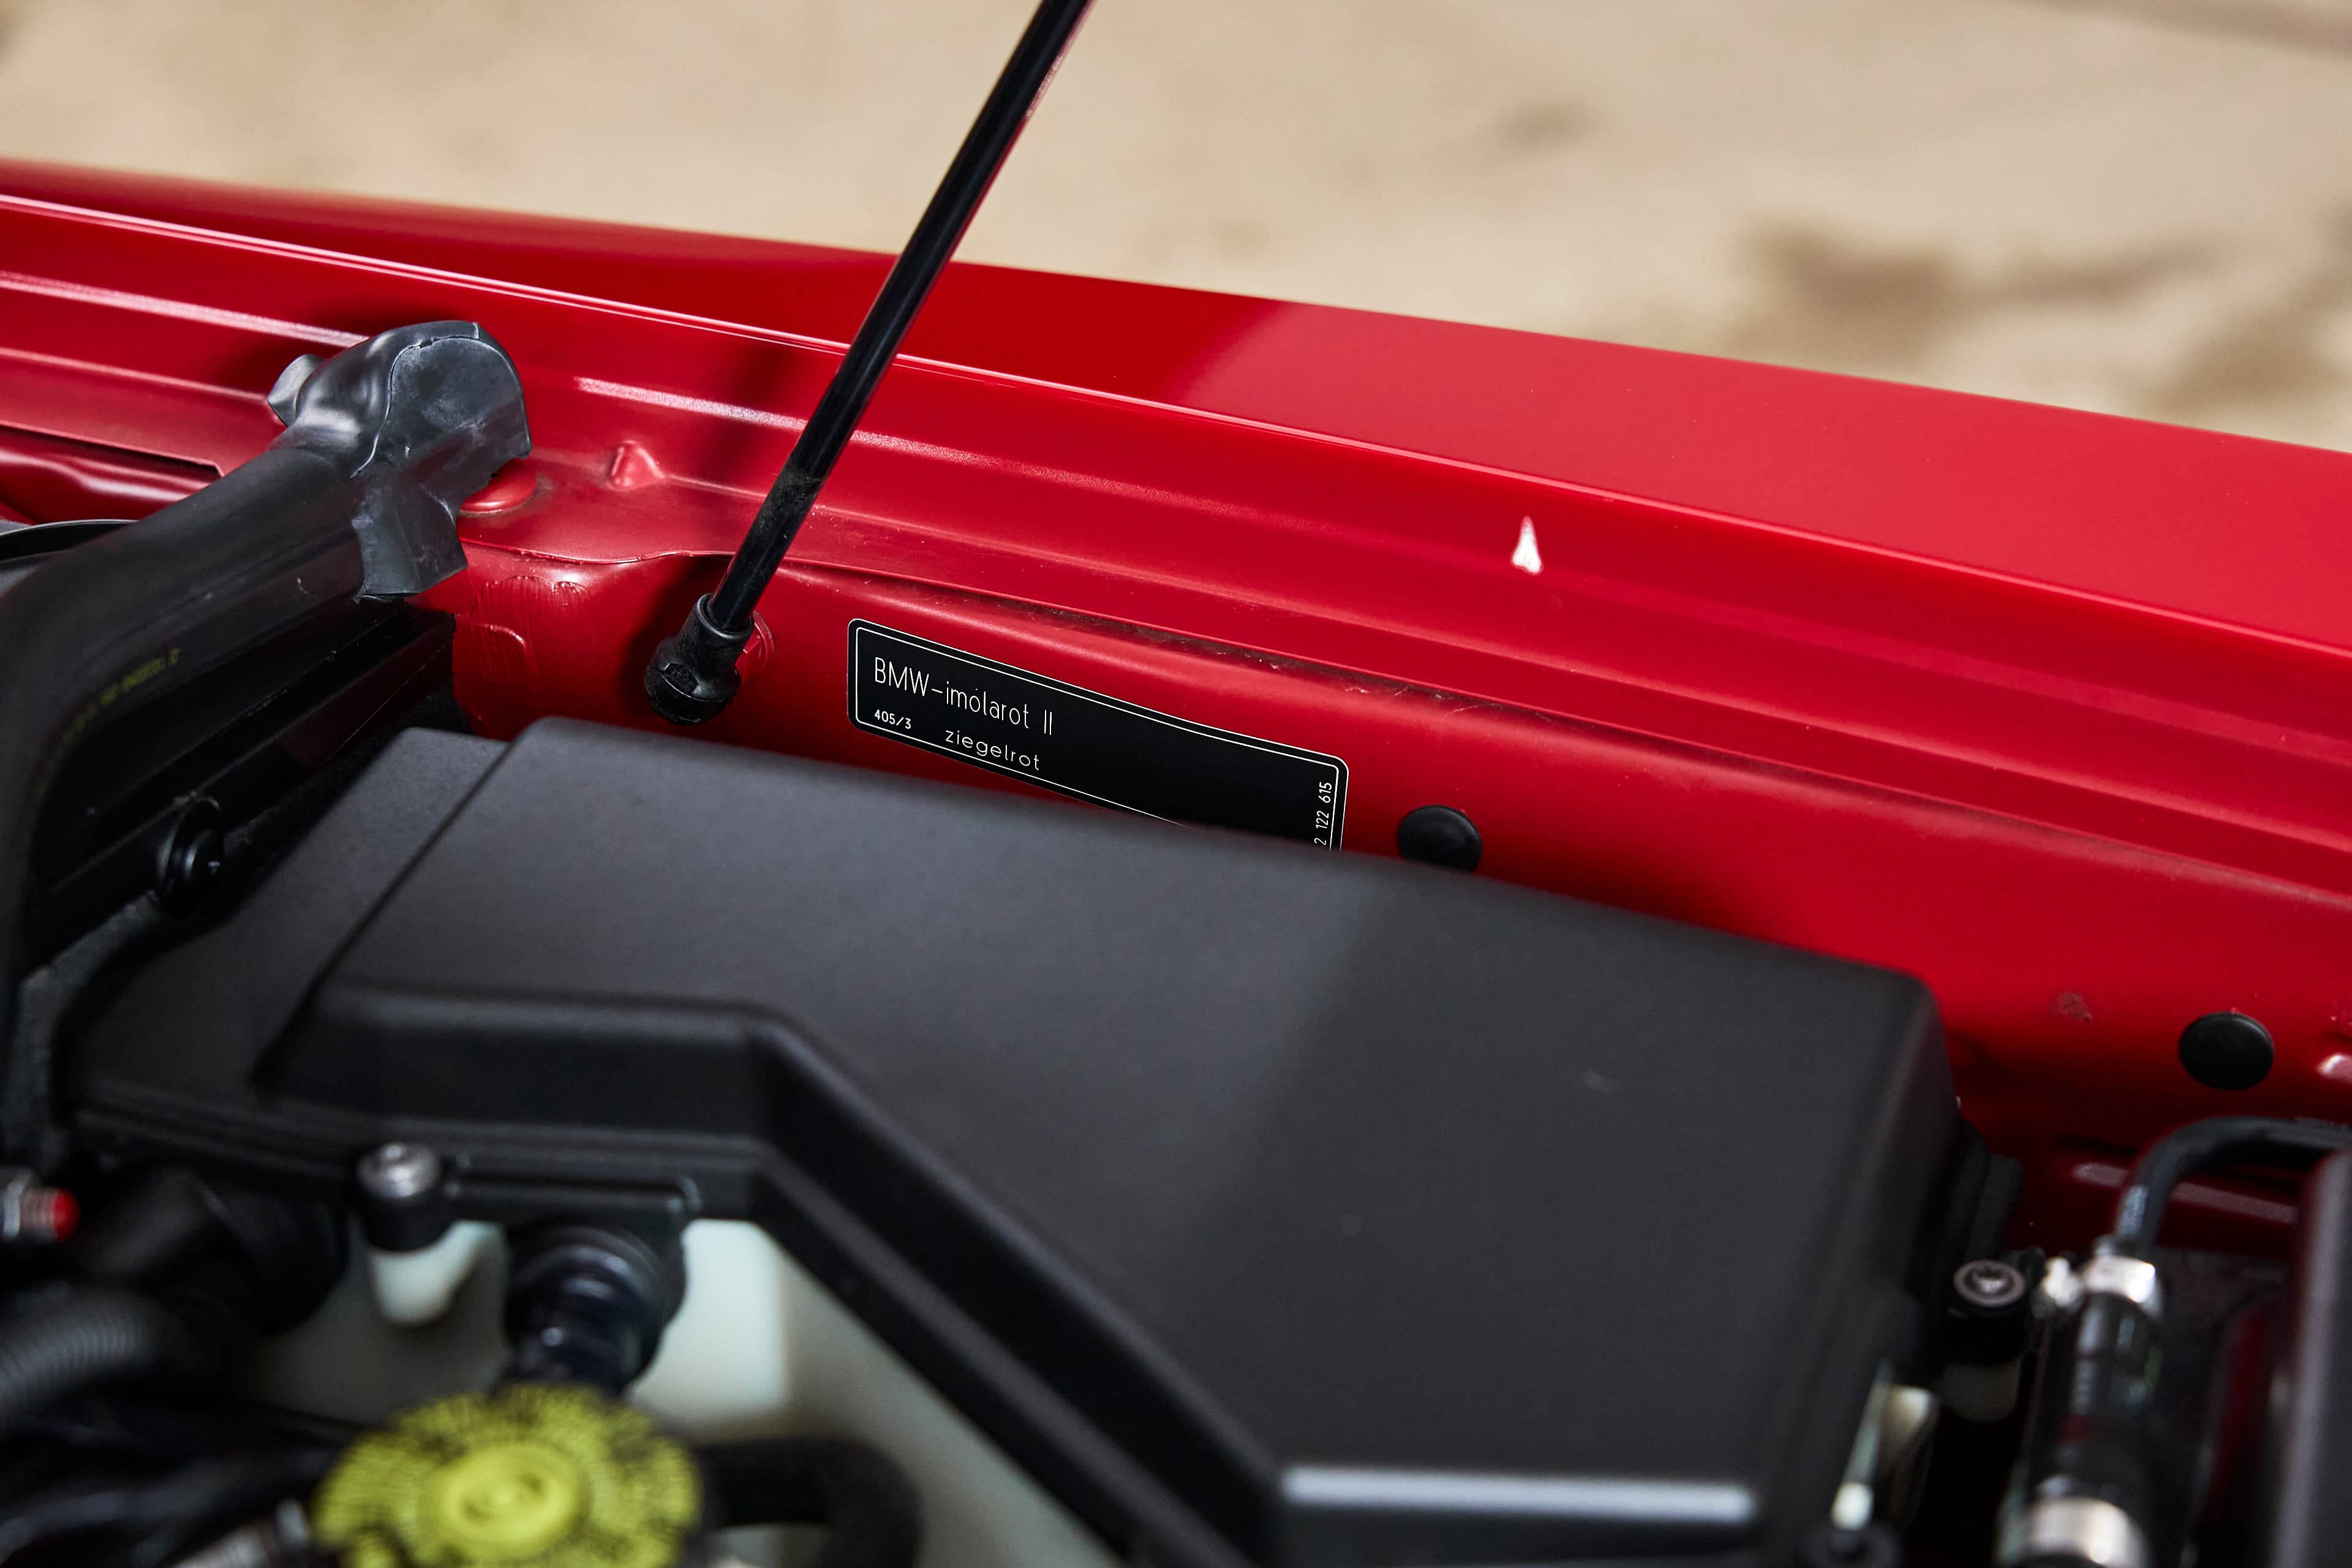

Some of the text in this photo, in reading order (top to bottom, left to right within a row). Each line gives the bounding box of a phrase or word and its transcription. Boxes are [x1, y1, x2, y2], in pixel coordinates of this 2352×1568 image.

[874, 709, 911, 729] 405/3
[875, 657, 1053, 736] BMW-imolarot II
[945, 729, 1039, 771] ziegelrot
[1314, 782, 1332, 846] 2 122 615
